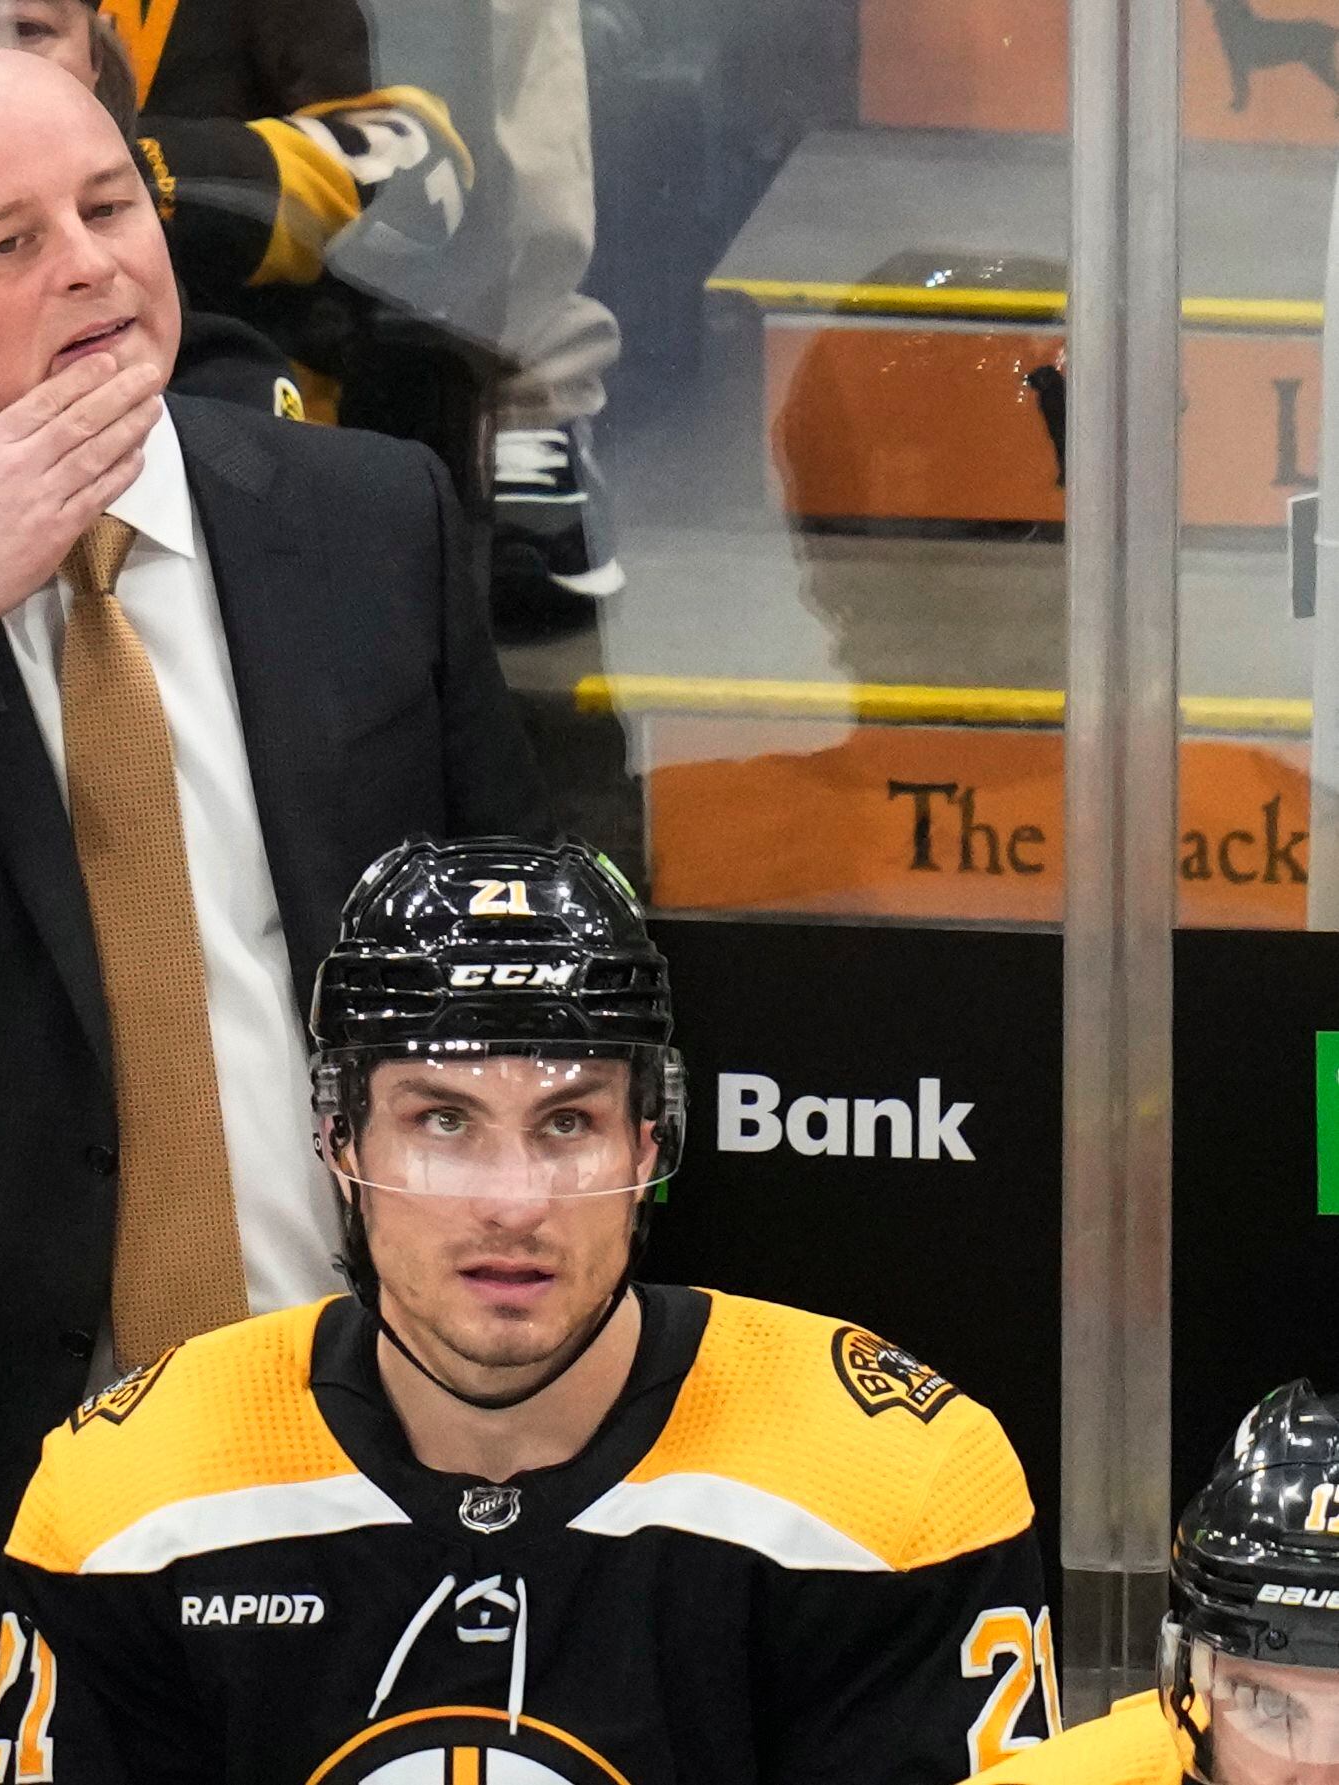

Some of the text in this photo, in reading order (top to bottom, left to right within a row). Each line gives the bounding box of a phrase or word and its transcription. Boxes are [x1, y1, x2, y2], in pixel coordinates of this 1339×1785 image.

[888, 778, 1310, 885] The ack
[468, 879, 536, 917] 21
[450, 963, 576, 988] CCM
[717, 1072, 977, 1162] Bank
[1304, 1483, 1339, 1533] 1
